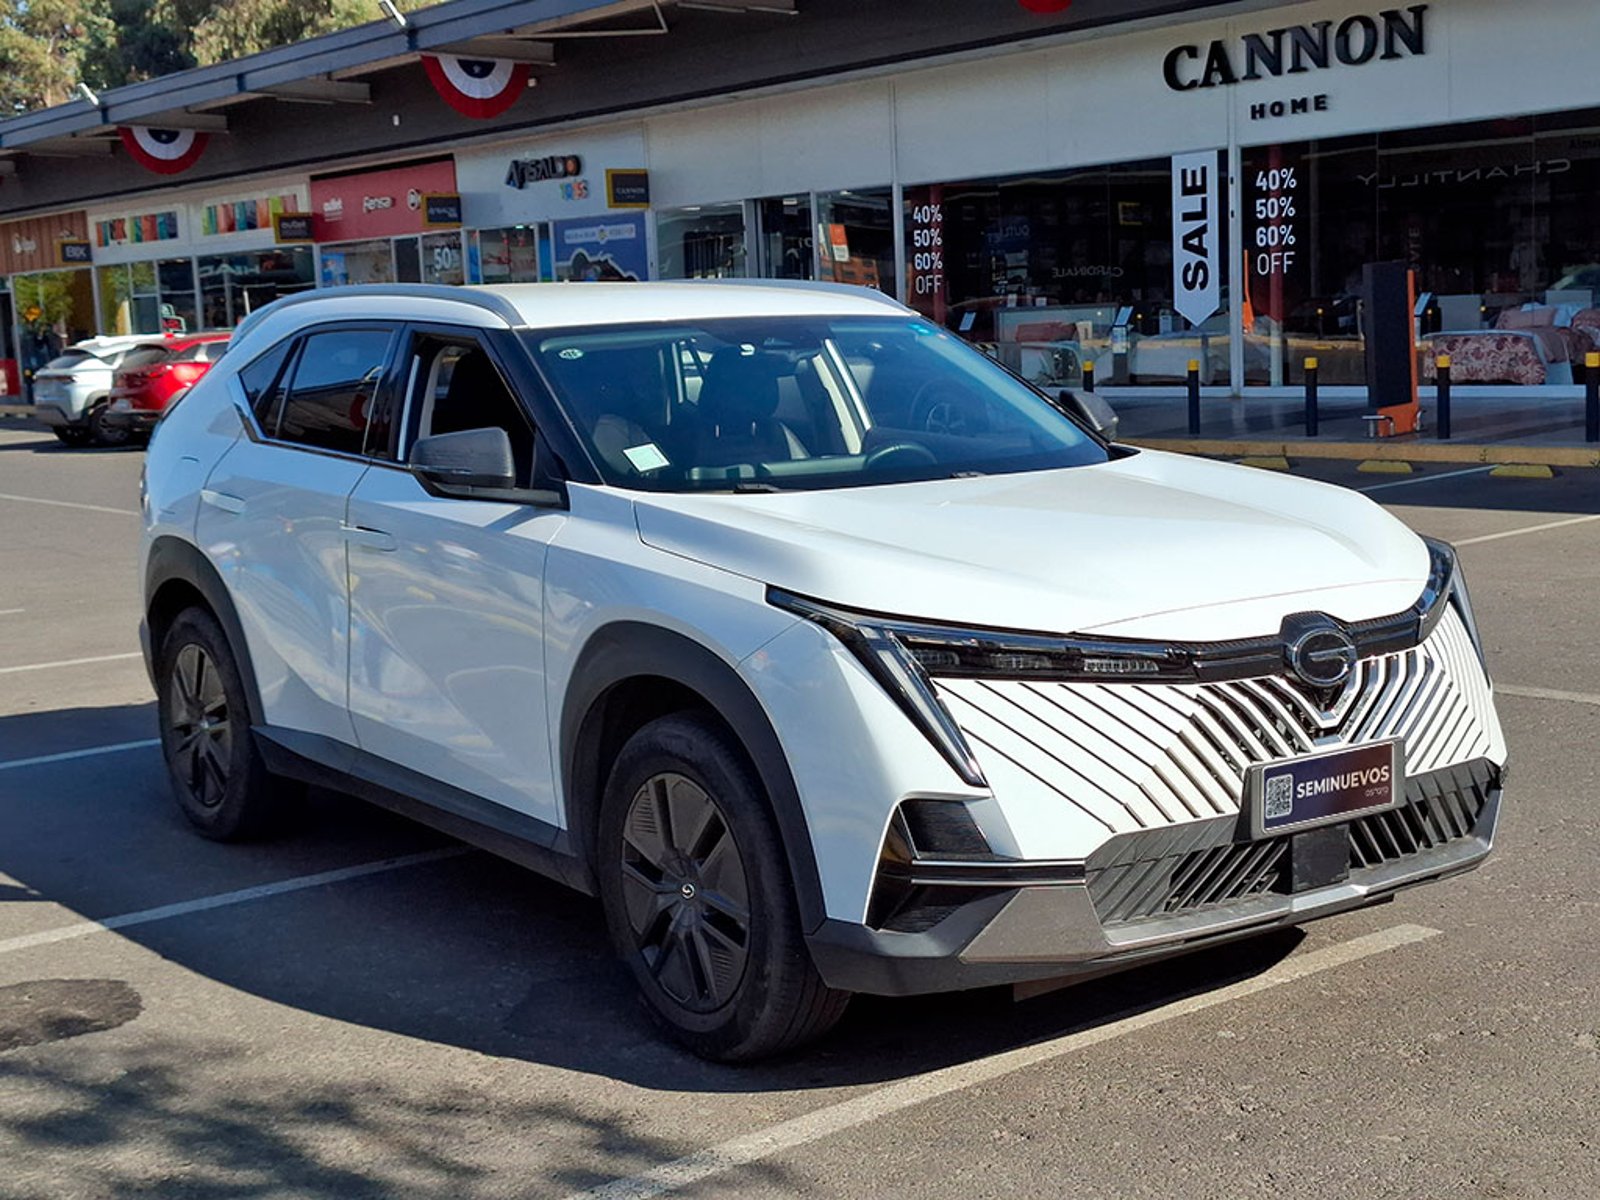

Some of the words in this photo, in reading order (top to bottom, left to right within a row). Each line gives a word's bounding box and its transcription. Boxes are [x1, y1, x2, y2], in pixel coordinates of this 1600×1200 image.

[1163, 5, 1428, 91] CANNON
[1251, 94, 1328, 120] HOME
[1255, 167, 1297, 191] 40%
[913, 204, 943, 223] 40%
[1255, 196, 1296, 219] 50%
[913, 228, 943, 247] 50%
[1181, 166, 1209, 291] SALE
[1256, 225, 1296, 247] 60%
[914, 252, 943, 270] 60%
[1257, 251, 1296, 276] OFF
[915, 274, 943, 294] OFF
[1296, 765, 1390, 799] SEMINUEVOS
